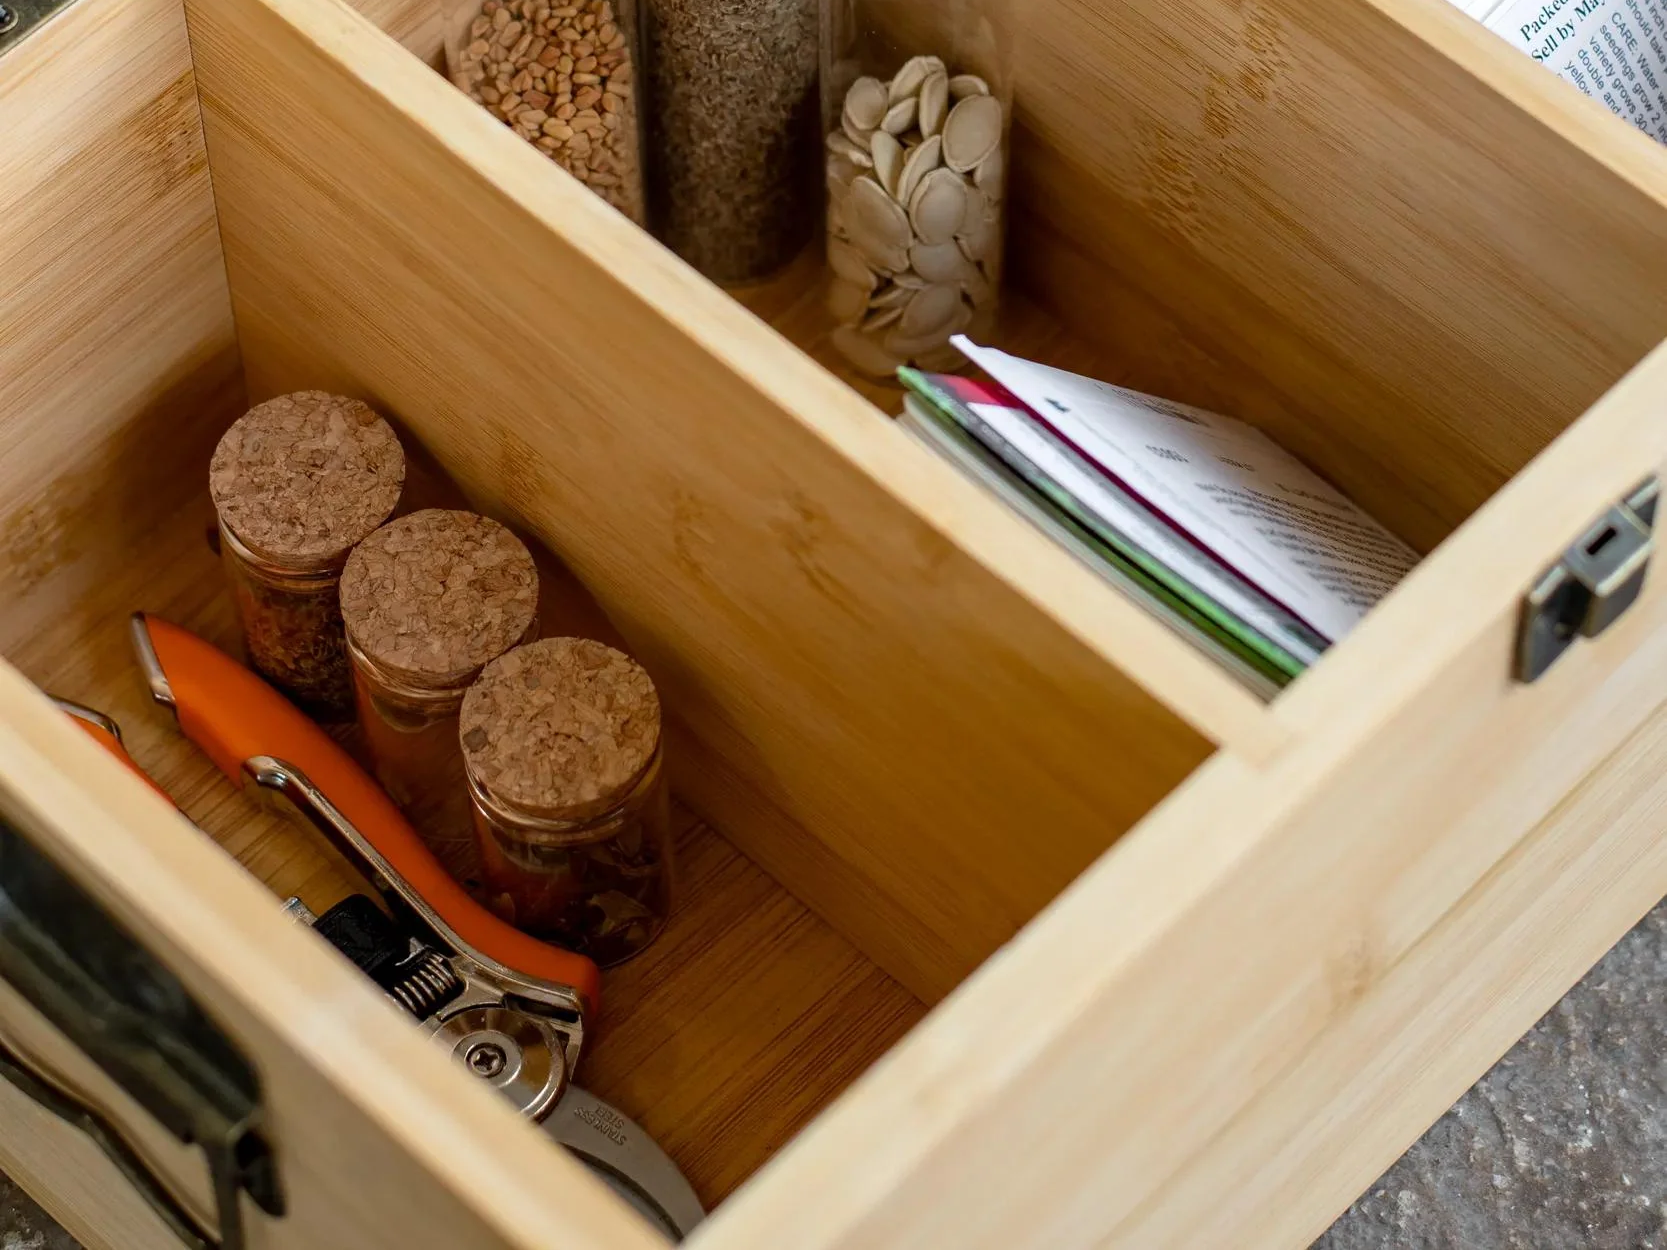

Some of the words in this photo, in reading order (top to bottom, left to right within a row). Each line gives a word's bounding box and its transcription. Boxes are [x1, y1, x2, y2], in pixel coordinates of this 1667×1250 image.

[1531, 35, 1559, 63] Sell
[1556, 18, 1577, 41] by
[1648, 5, 1666, 31] inch
[1650, 35, 1667, 64] take
[1577, 49, 1605, 90] double
[1603, 91, 1622, 114] and
[1589, 35, 1616, 78] variety
[1611, 77, 1637, 114] grows
[1599, 24, 1636, 82] seedlings
[1632, 82, 1654, 113] grow
[1651, 112, 1661, 125] 2
[1610, 12, 1638, 56] CARE:
[1636, 53, 1660, 91] Water
